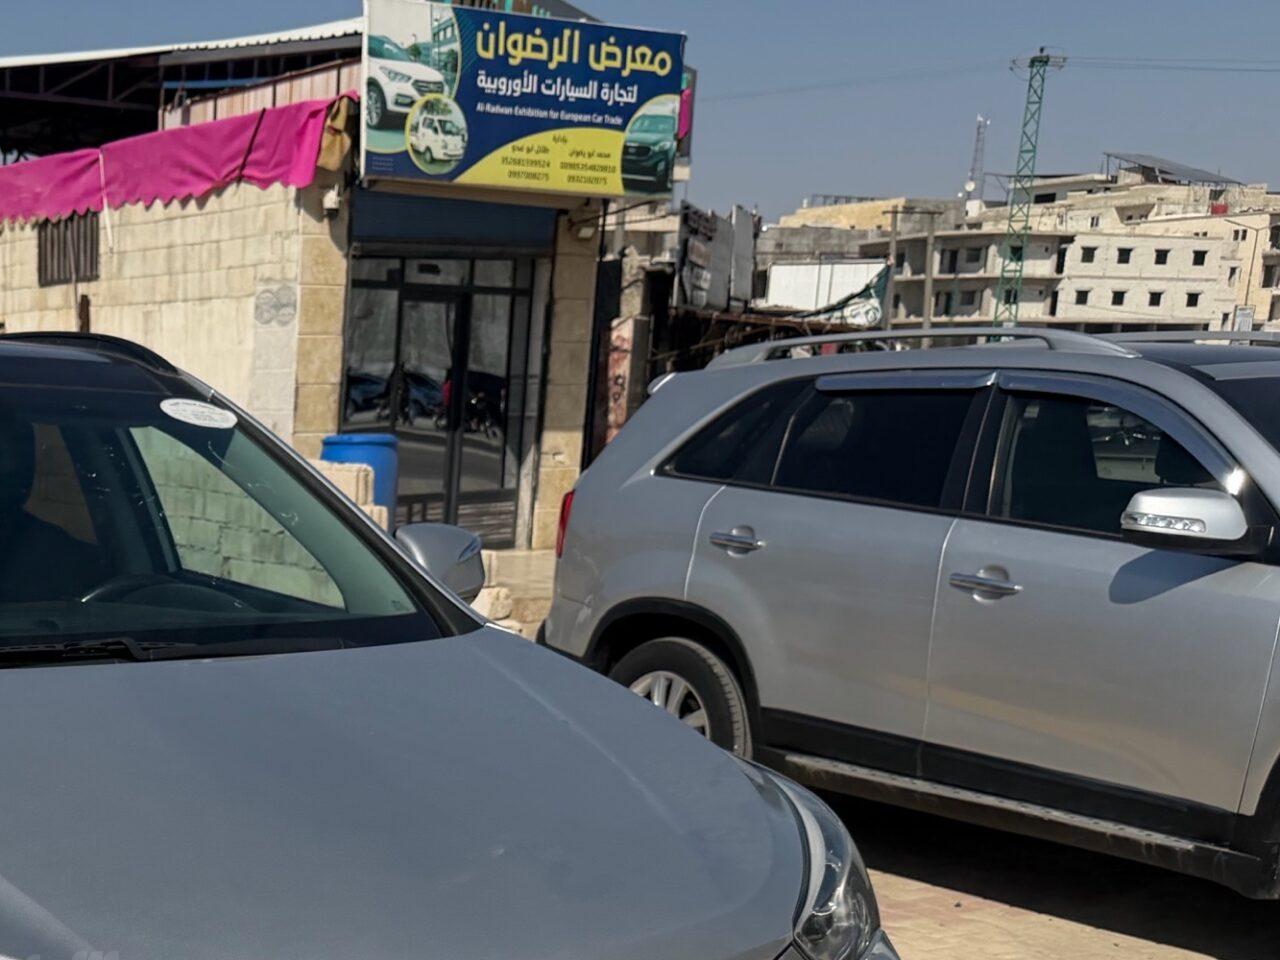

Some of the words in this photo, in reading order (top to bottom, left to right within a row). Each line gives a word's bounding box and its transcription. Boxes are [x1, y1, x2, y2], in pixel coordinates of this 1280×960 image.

[476, 21, 580, 70] الرضوان
[588, 36, 672, 77] معرض
[477, 69, 538, 97] الأوروبية
[541, 76, 597, 101] السيارات
[600, 83, 638, 106] لتجارة
[514, 105, 548, 118] Exhibition
[549, 108, 559, 120] for
[560, 110, 591, 123] European
[591, 113, 604, 124] Car
[604, 115, 623, 126] Trade
